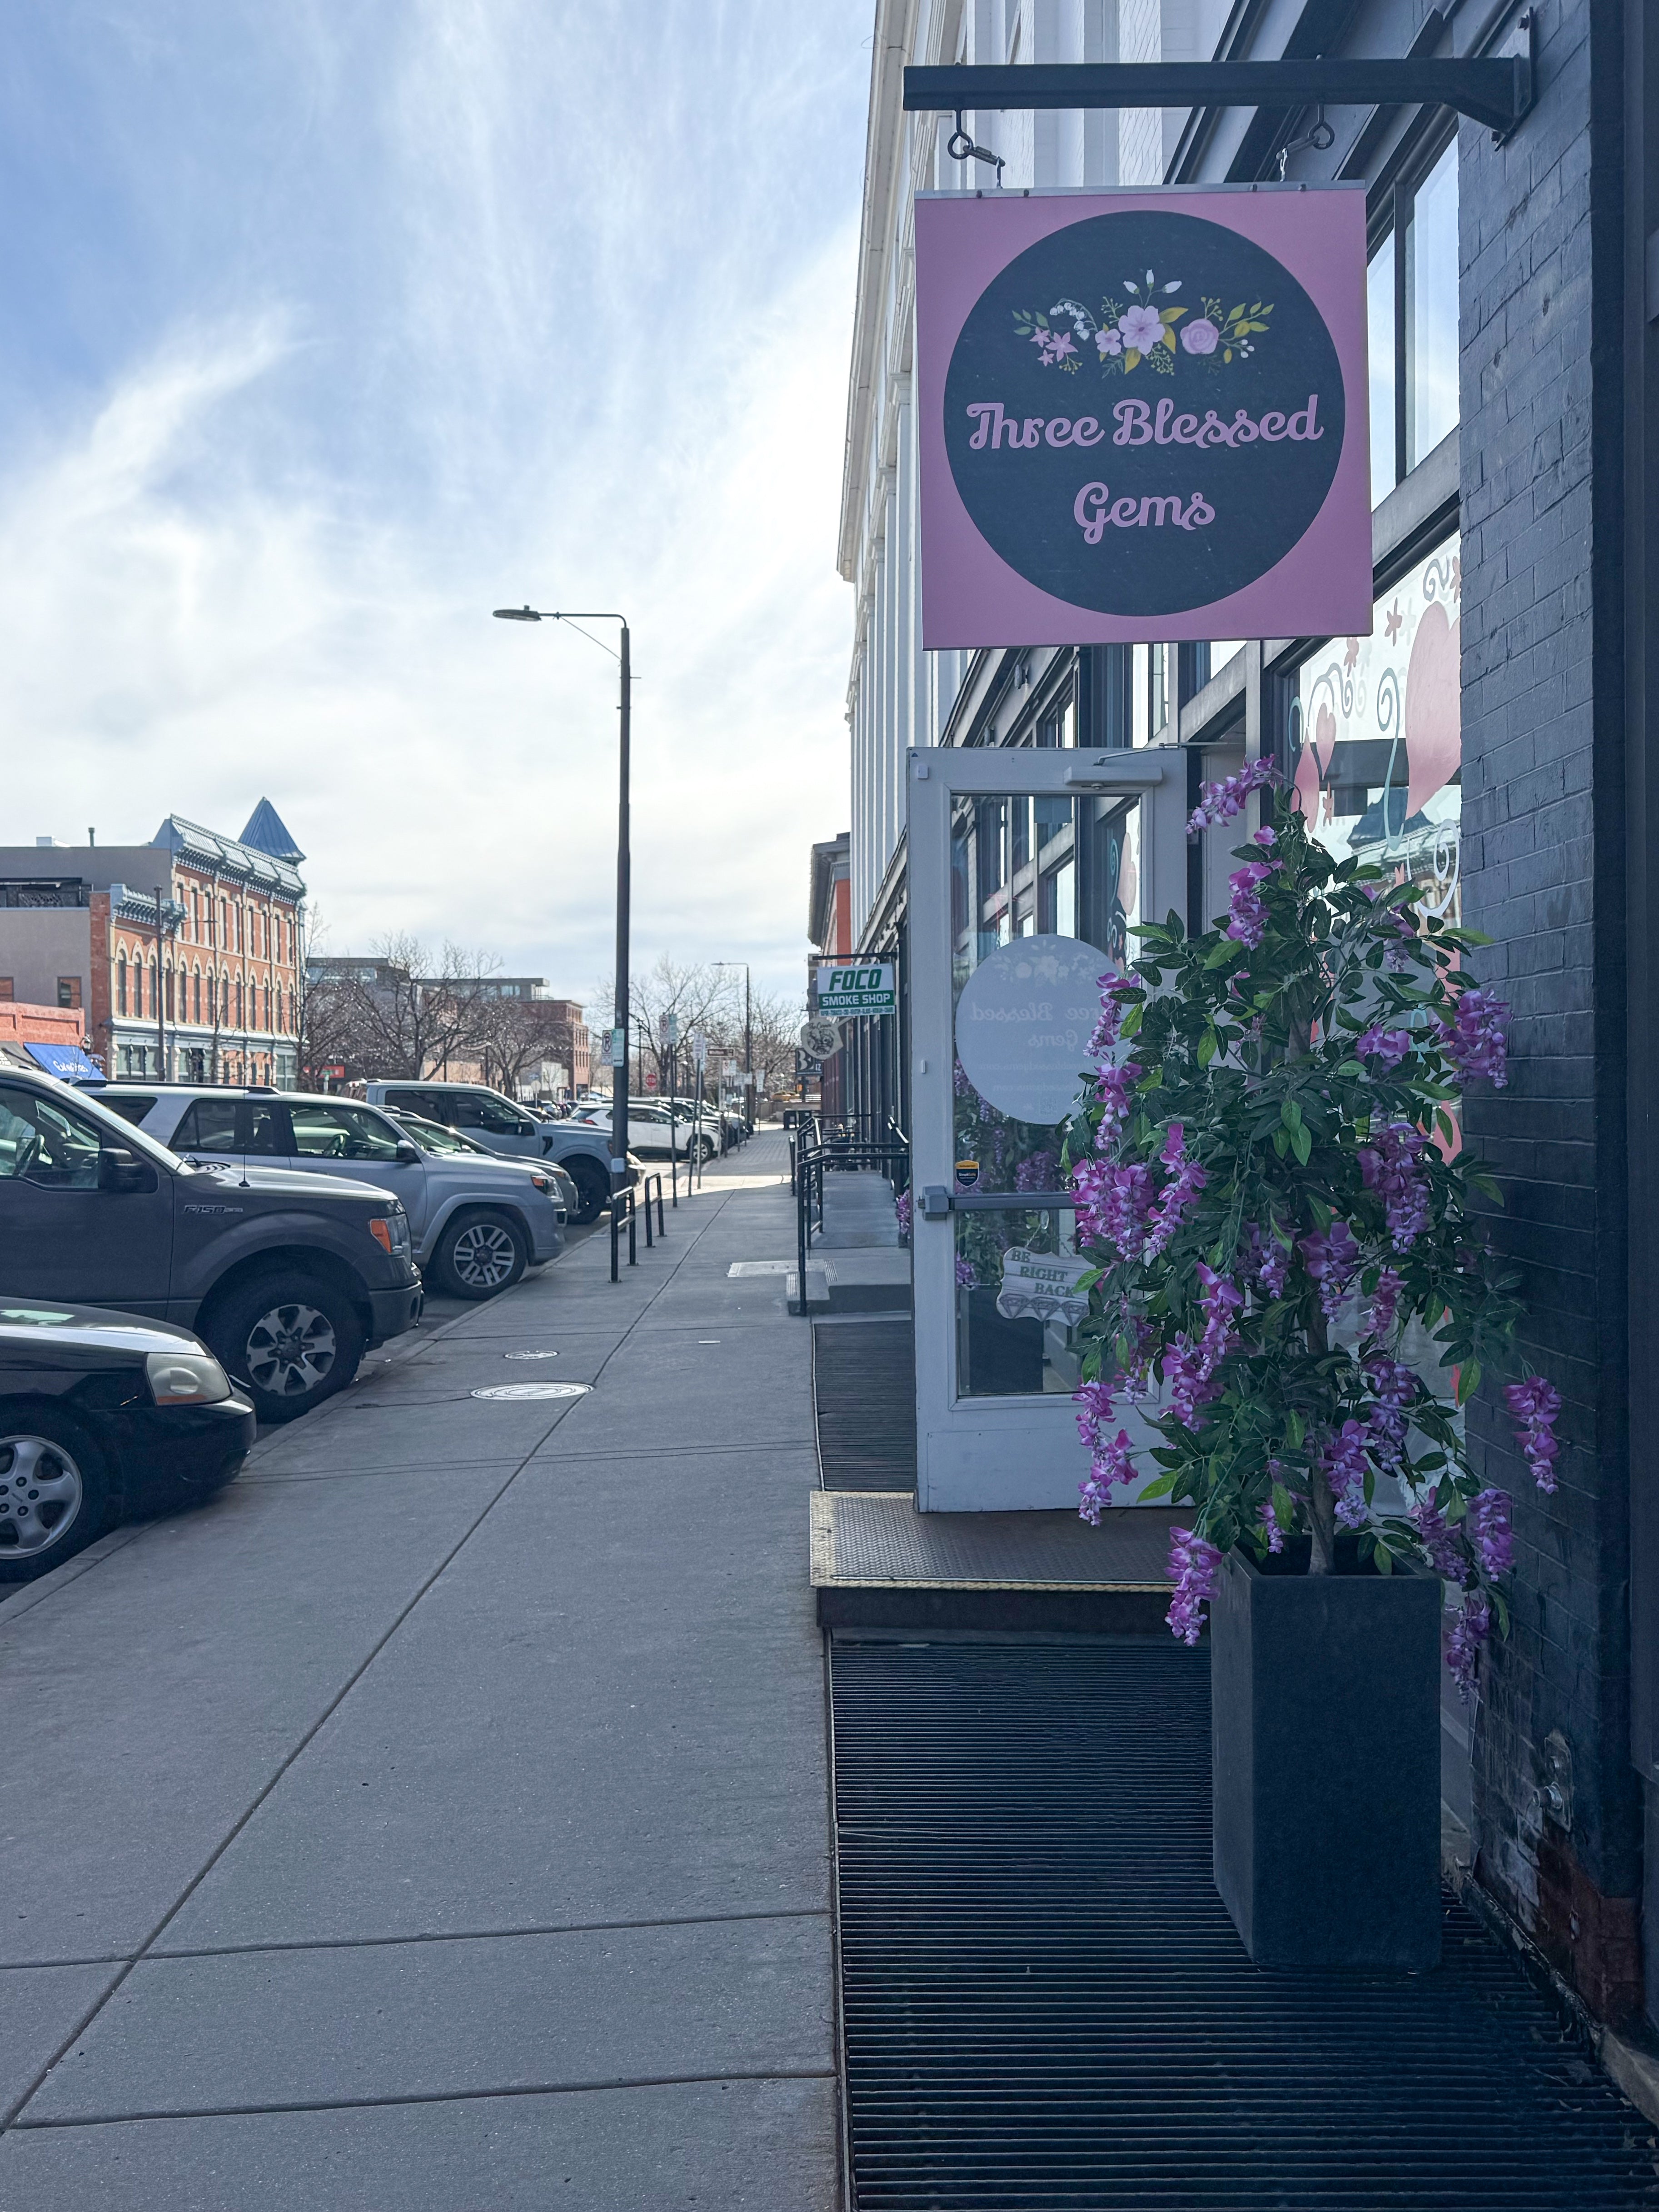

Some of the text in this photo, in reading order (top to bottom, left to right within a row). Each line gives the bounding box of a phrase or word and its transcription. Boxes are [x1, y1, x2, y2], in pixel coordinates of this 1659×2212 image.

[967, 394, 1324, 449] Three Blessed
[1074, 482, 1215, 544] Gems
[829, 969, 882, 991] FOCO
[822, 993, 891, 1006] SMOKE SHOP
[1011, 1250, 1031, 1262] BE
[1020, 1266, 1068, 1282] RIGHT
[1035, 1283, 1075, 1298] BACK
